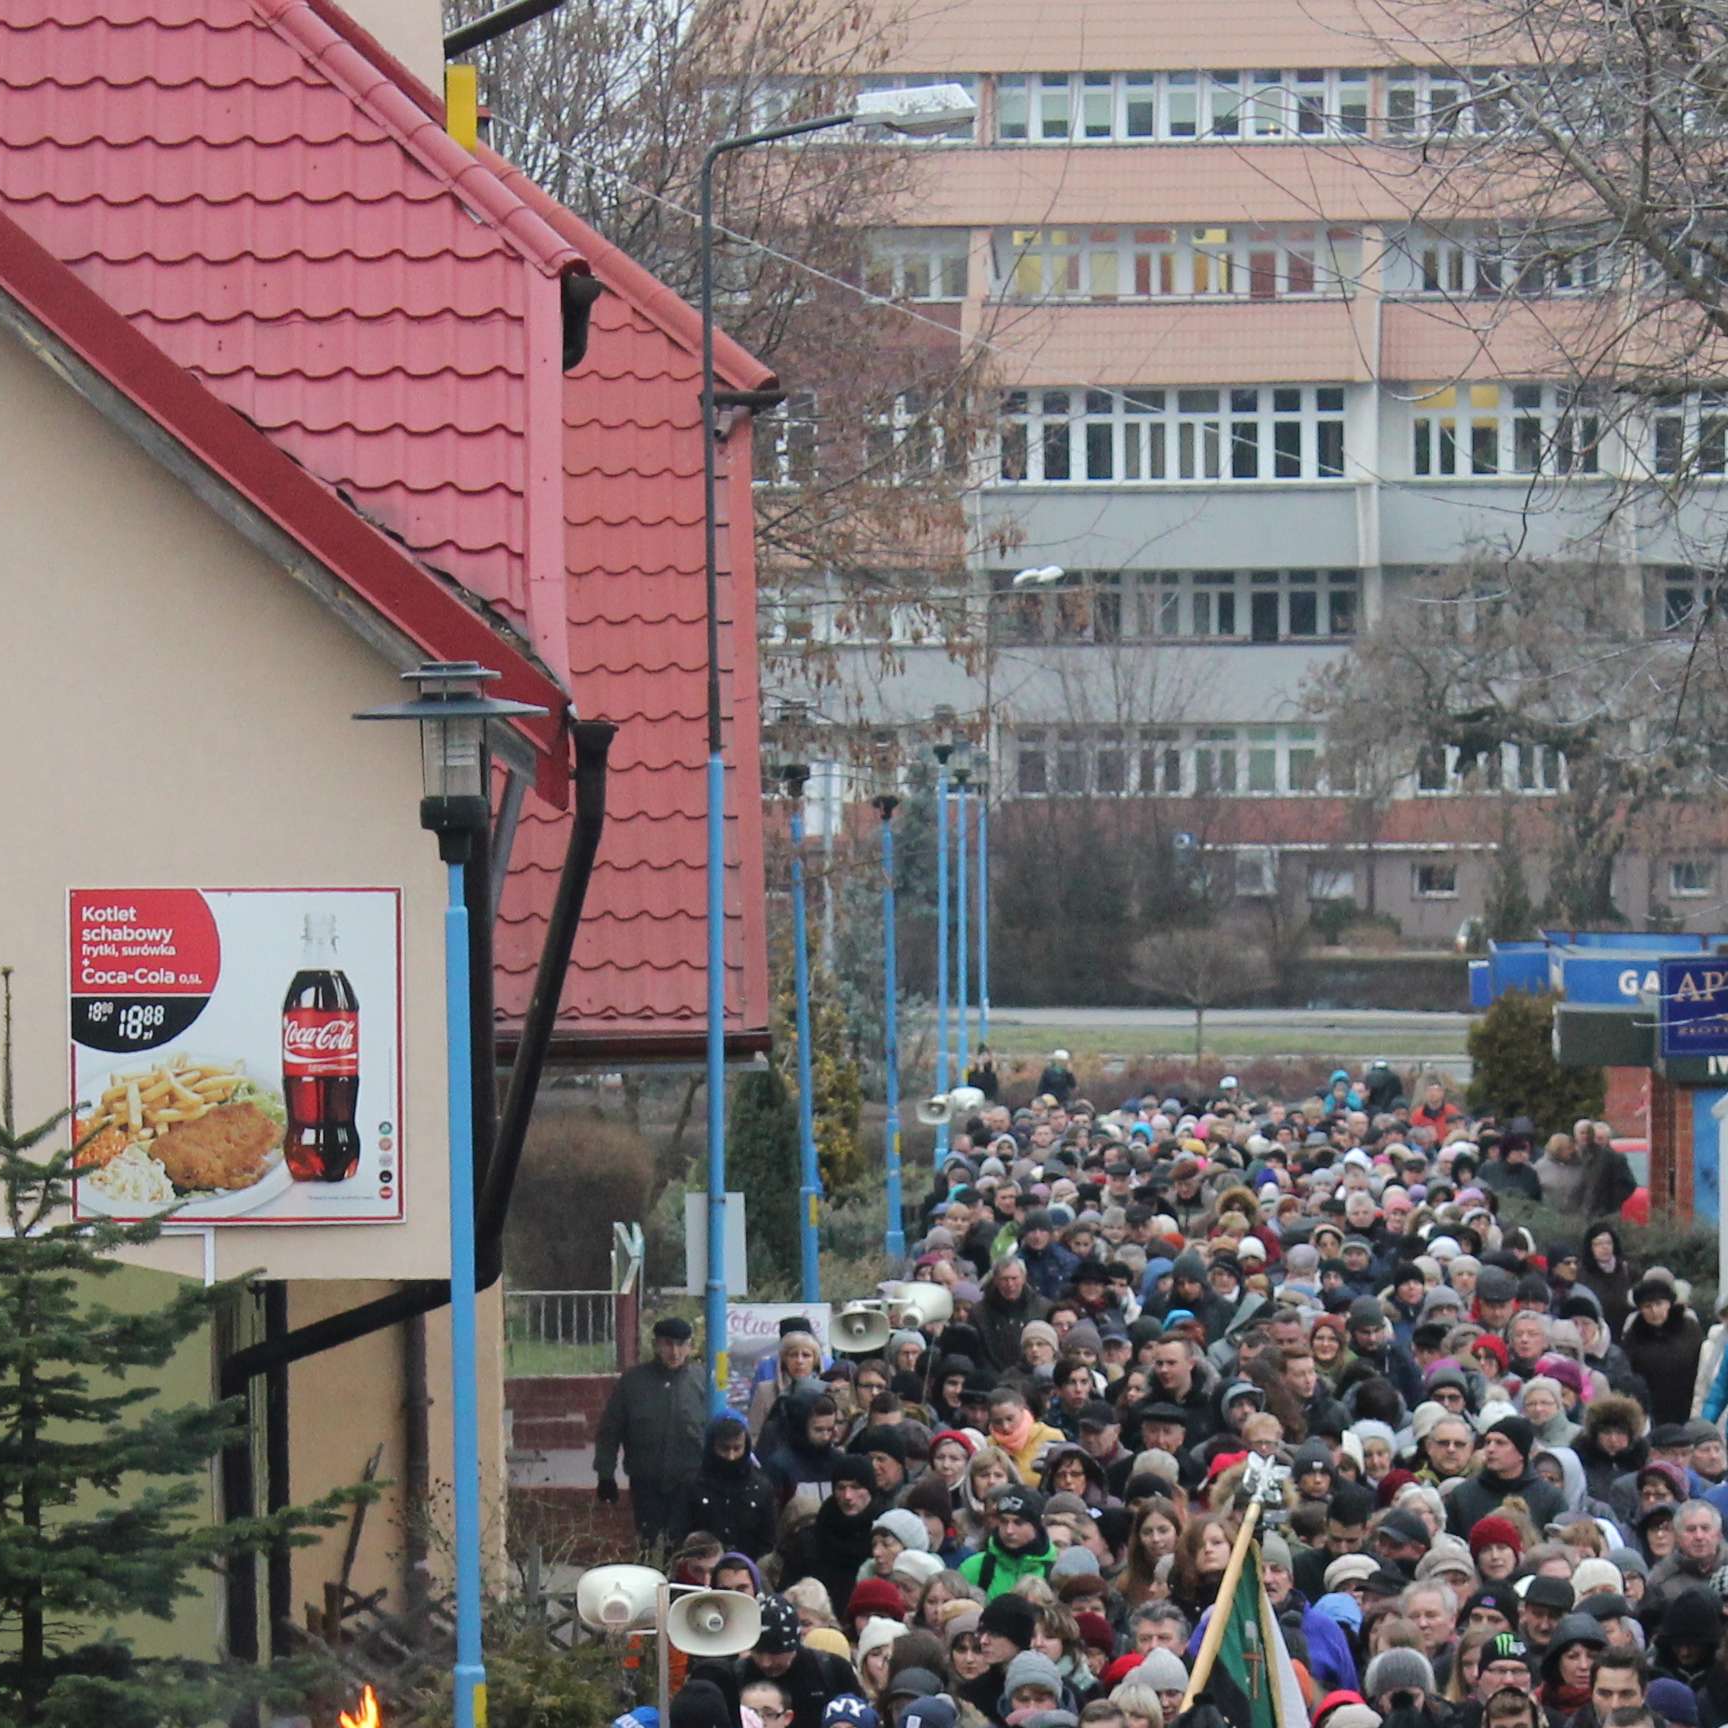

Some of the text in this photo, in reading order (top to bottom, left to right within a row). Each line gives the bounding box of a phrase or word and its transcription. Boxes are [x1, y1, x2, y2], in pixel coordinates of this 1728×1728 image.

[81, 905, 136, 922] Kotlet
[81, 925, 173, 944] schabowy
[81, 967, 175, 985] Coca-Cola
[284, 1020, 354, 1050] Coca-Cola
